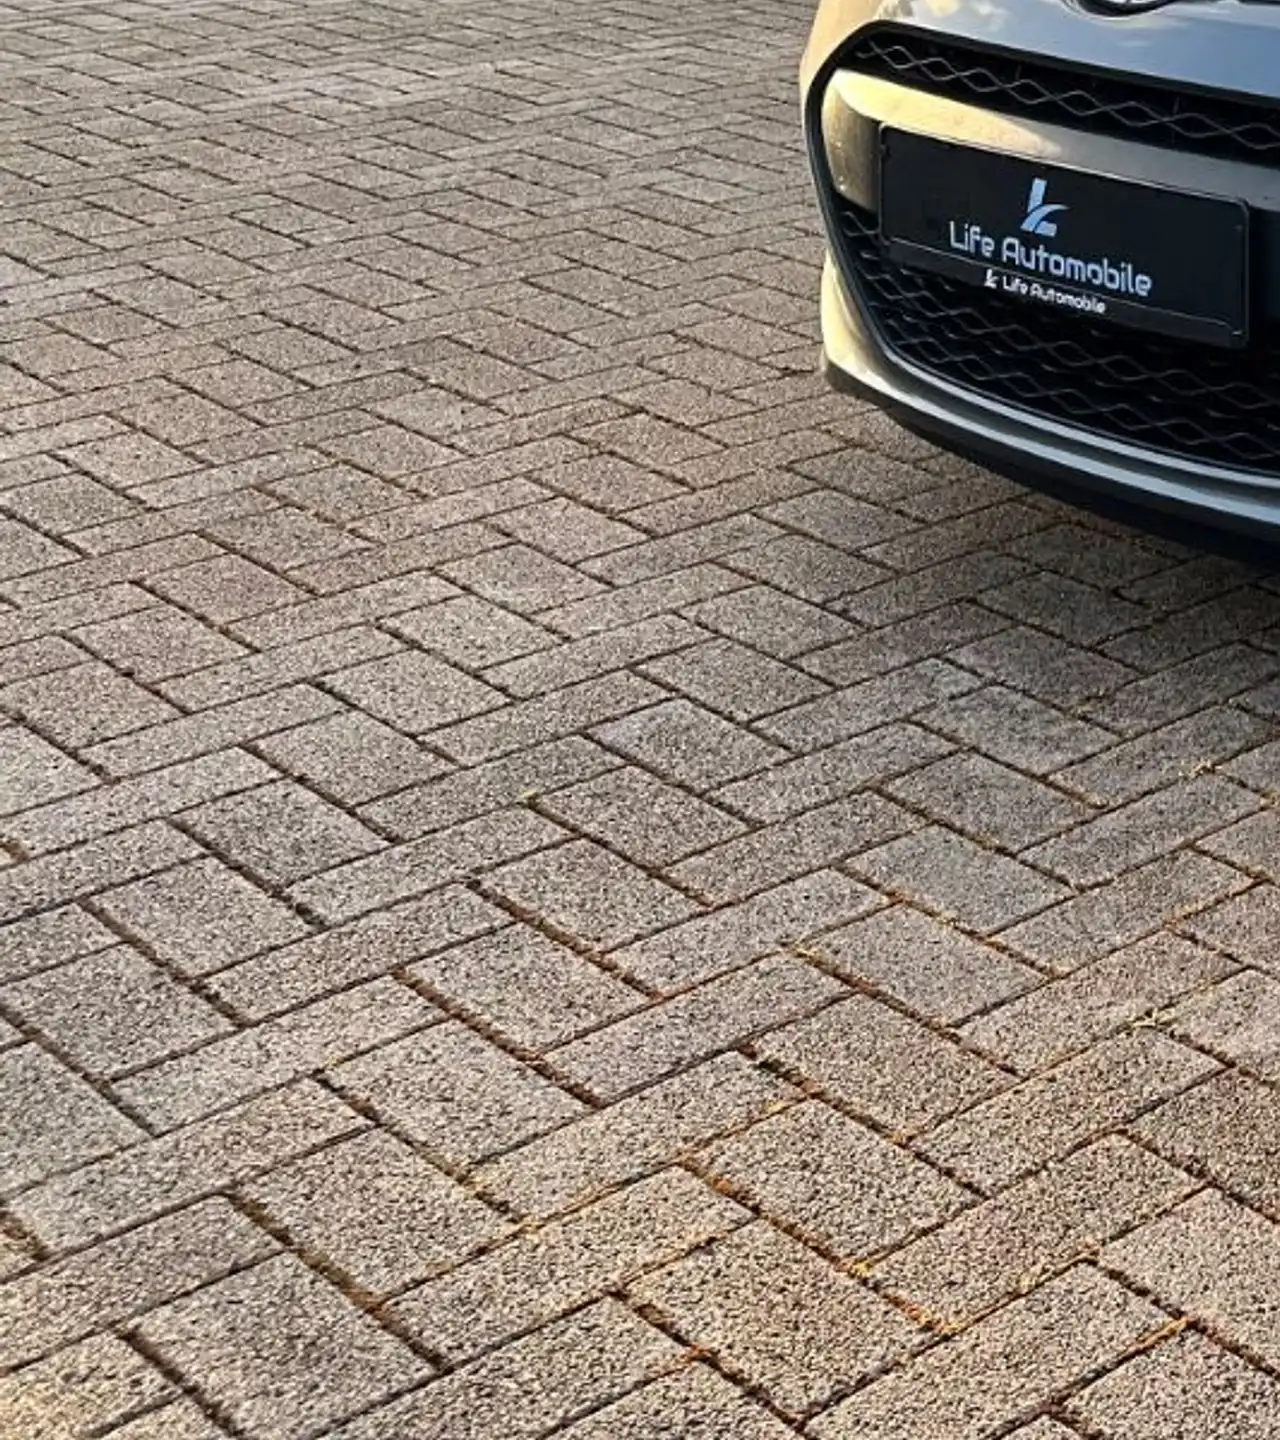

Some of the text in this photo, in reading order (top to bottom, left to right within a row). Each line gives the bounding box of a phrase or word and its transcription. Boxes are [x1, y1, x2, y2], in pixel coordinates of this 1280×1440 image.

[949, 221, 1152, 296] Life Automobile
[1002, 275, 1106, 314] Life Automobile
